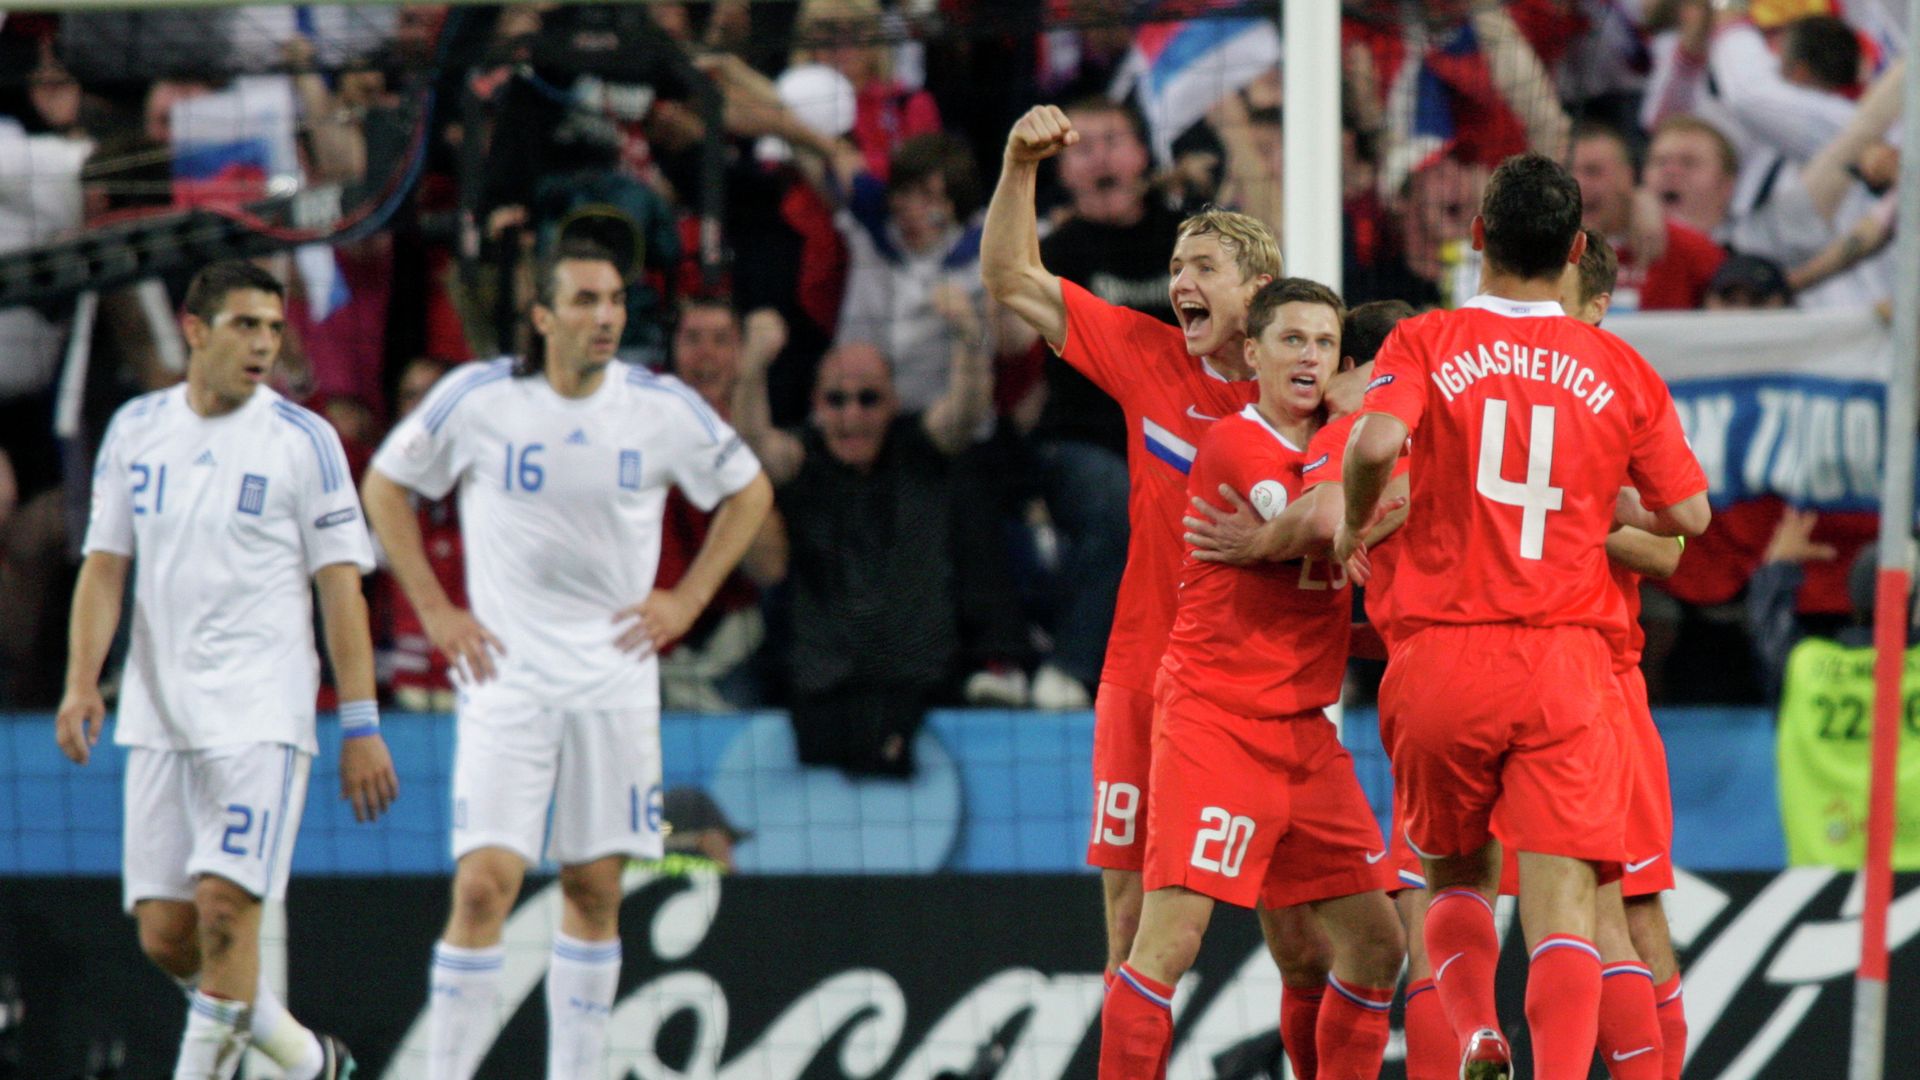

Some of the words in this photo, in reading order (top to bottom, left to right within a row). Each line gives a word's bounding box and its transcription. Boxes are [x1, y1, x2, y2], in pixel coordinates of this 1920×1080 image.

[1431, 340, 1615, 415] IGNASHEVICH
[131, 463, 167, 515] 21
[505, 442, 545, 492] 16
[1476, 398, 1563, 560] 4
[221, 804, 270, 859] 21
[630, 784, 664, 833] 16
[1093, 781, 1141, 846] 19
[1190, 806, 1256, 878] 20
